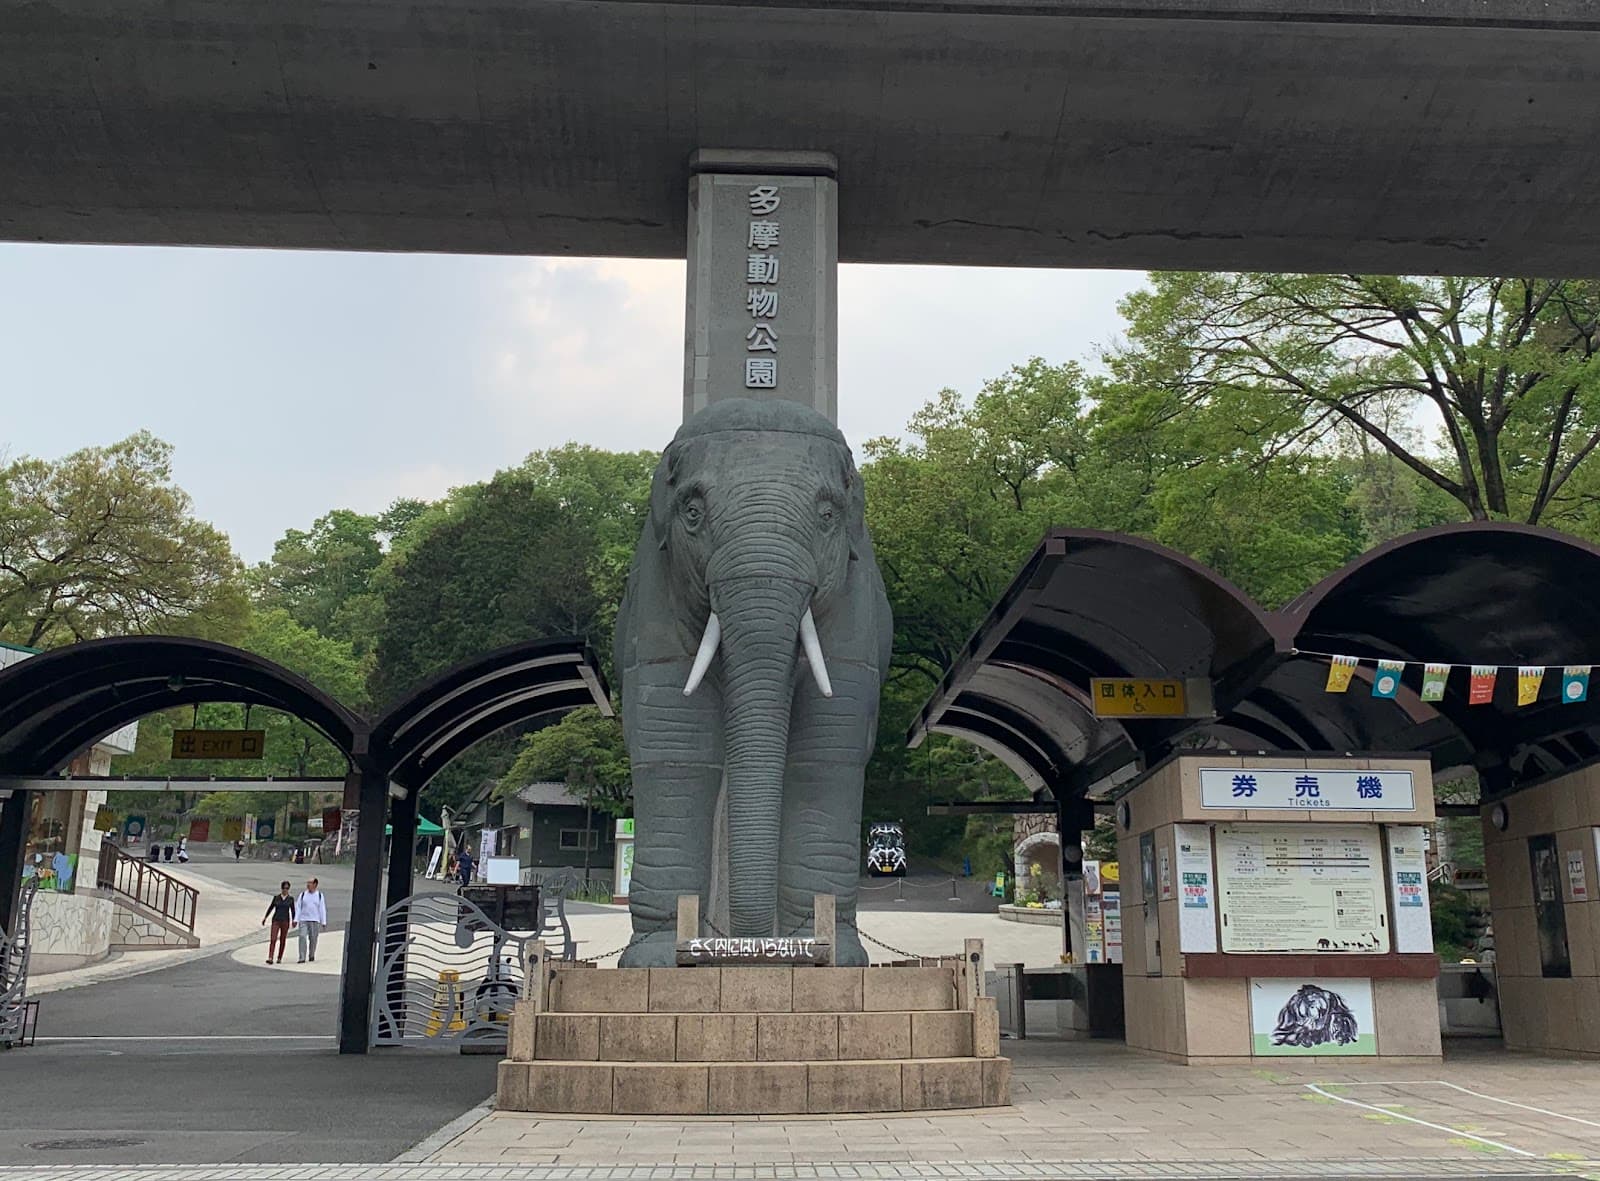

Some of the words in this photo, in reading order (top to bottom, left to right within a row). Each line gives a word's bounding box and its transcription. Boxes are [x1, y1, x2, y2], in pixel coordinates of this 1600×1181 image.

[745, 185, 781, 389] 多摩動物公園
[1101, 683, 1176, 698] 団体入口
[202, 740, 233, 752] EXIT
[1231, 774, 1383, 799] 券売機
[1288, 798, 1331, 807] Tickets
[690, 938, 816, 958] さく内にはいらないで
